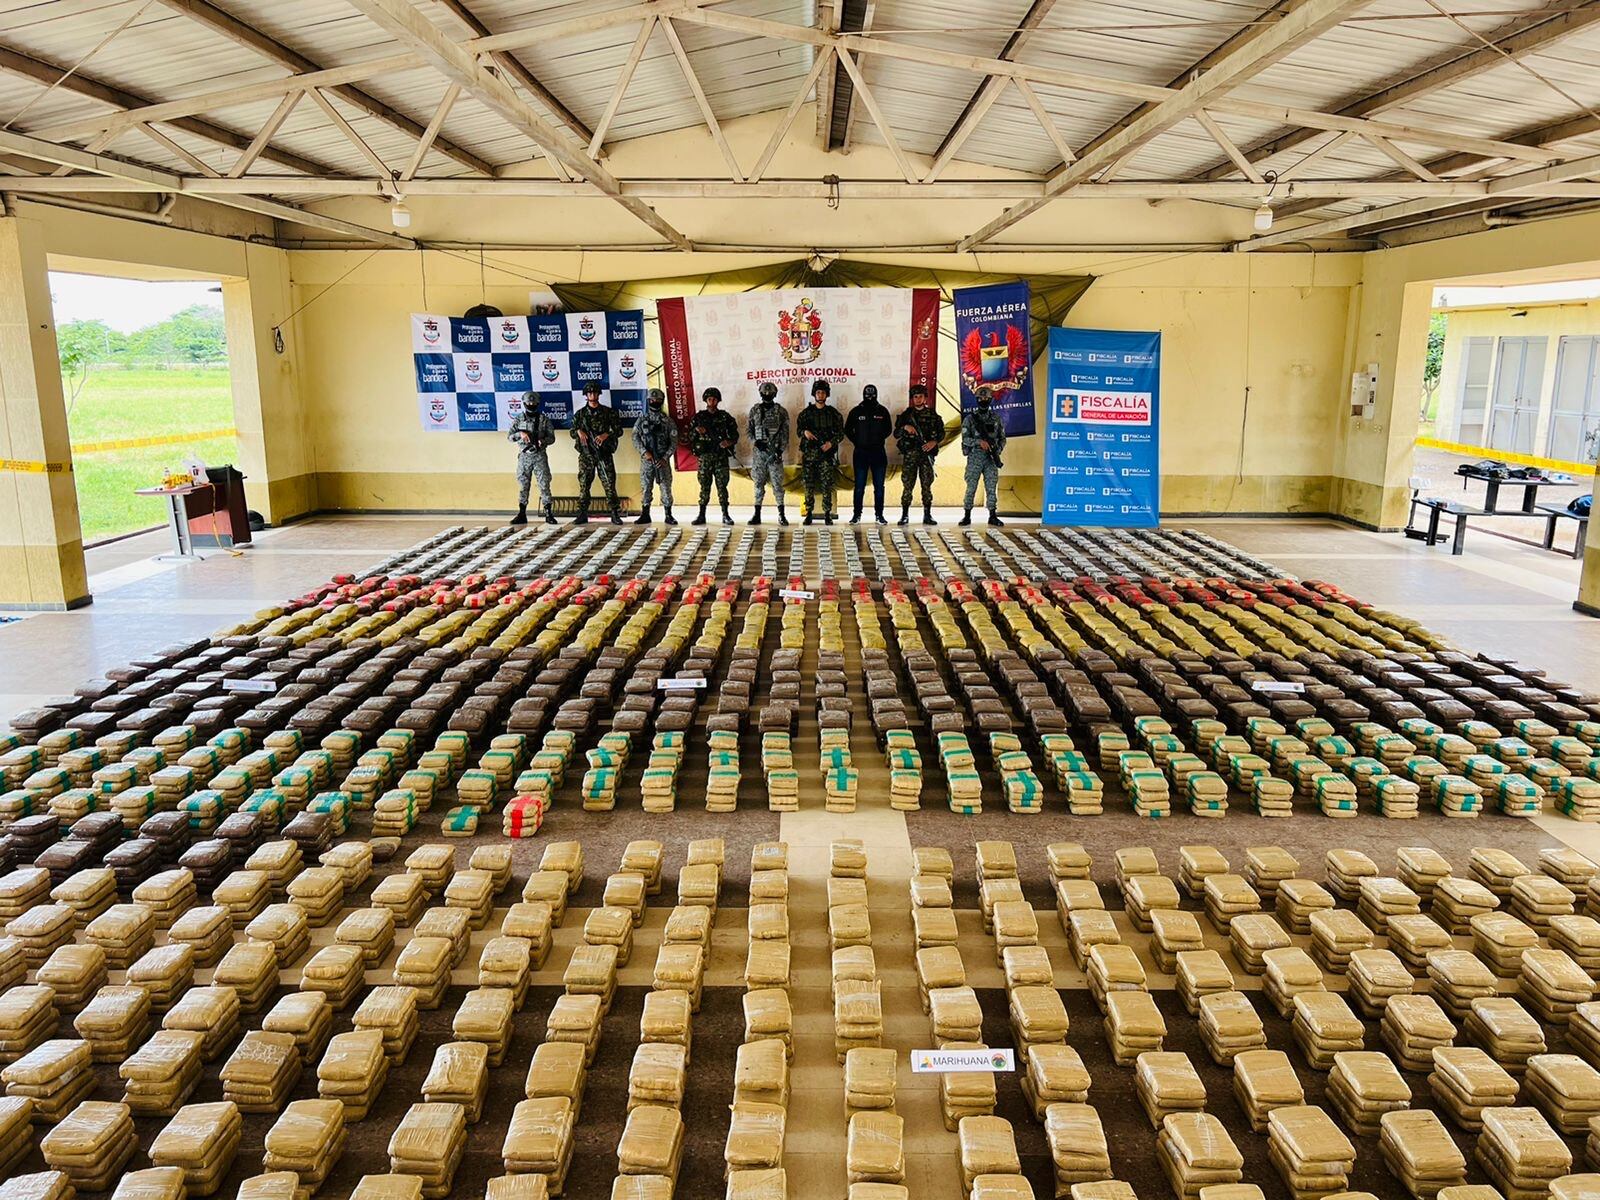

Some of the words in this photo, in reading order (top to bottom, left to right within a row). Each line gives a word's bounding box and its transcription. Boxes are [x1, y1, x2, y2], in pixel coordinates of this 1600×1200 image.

[956, 307, 993, 317] FUERZA
[996, 302, 1027, 314] AÉREA
[971, 314, 1013, 323] COLOMBIANA
[458, 333, 484, 343] bandera
[536, 333, 562, 342] bandera
[612, 330, 638, 340] bandera
[669, 338, 679, 380] NACIONAL
[676, 341, 684, 369] LEALTAD
[422, 373, 448, 382] bandera
[499, 373, 525, 382] bandera
[577, 371, 603, 380] bandera
[747, 369, 798, 380] EJÉRCITO
[801, 368, 856, 376] NACIONAL
[679, 371, 687, 393] HONOR
[1081, 395, 1148, 408] FISCALÍA
[464, 412, 490, 421] bandera
[1082, 411, 1107, 419] GENERAL
[1126, 412, 1147, 420] NACIÓN
[933, 1057, 990, 1065] MARIHUANA
